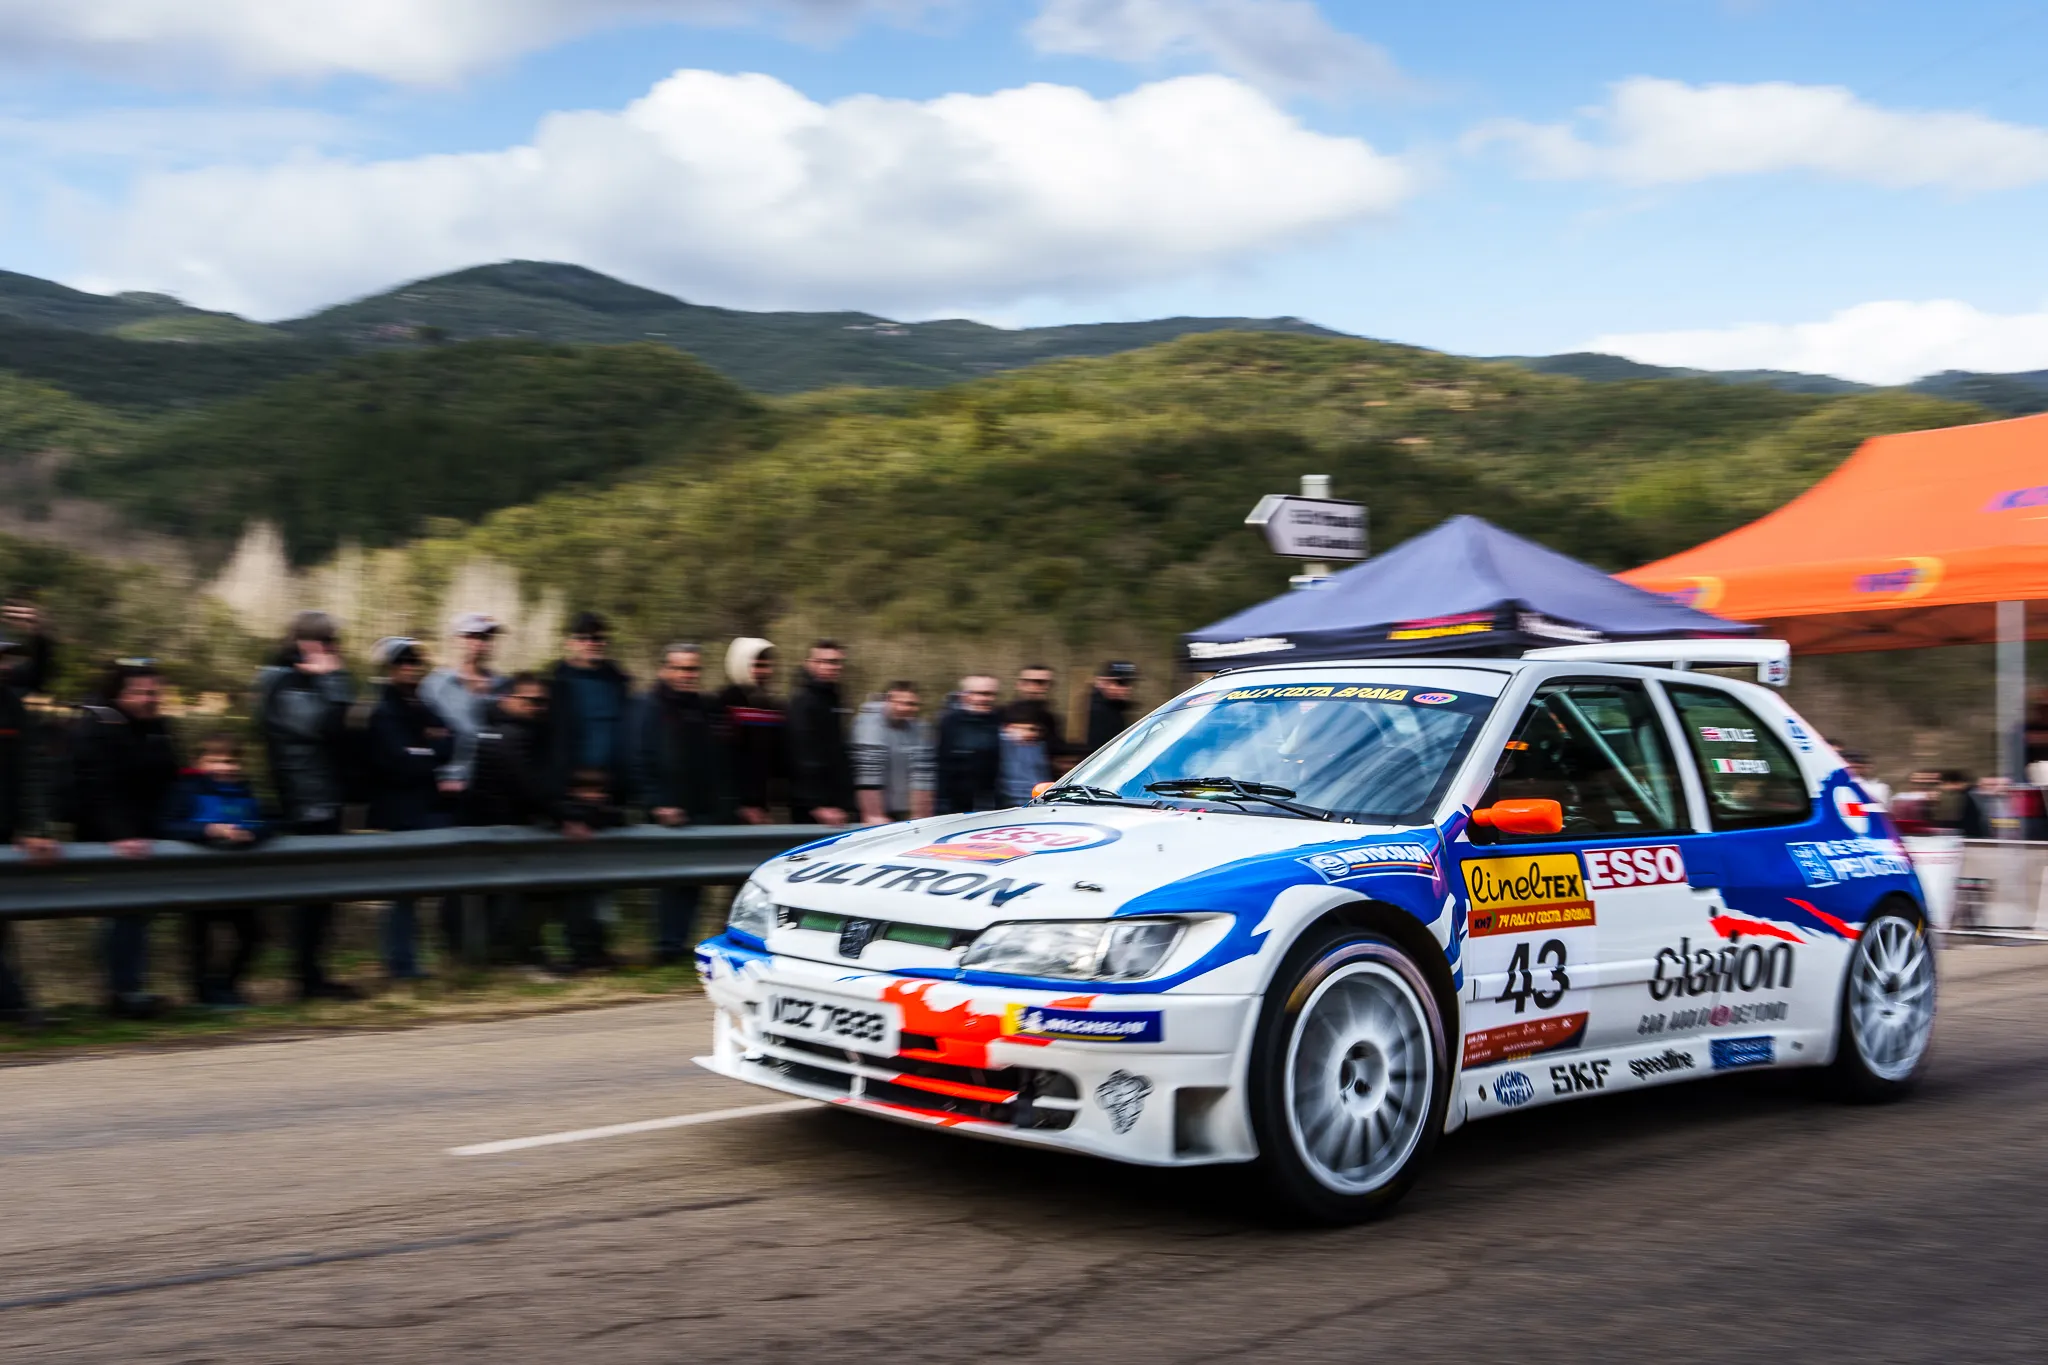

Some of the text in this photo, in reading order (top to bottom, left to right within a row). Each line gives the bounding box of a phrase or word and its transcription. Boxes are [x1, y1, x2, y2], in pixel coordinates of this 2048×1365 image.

[1223, 687, 1277, 701] RALLY
[1278, 686, 1336, 698] COSTA
[1331, 687, 1409, 701] BRAVA
[786, 861, 1044, 908] ULTRON
[1585, 848, 1686, 888] ESSO
[1498, 914, 1510, 928] 74
[1509, 911, 1536, 927] RALLY
[1536, 910, 1562, 925] COSTA
[1495, 939, 1570, 1014] 43
[1648, 929, 1797, 1001] clarion
[1549, 1058, 1612, 1096] SKF
